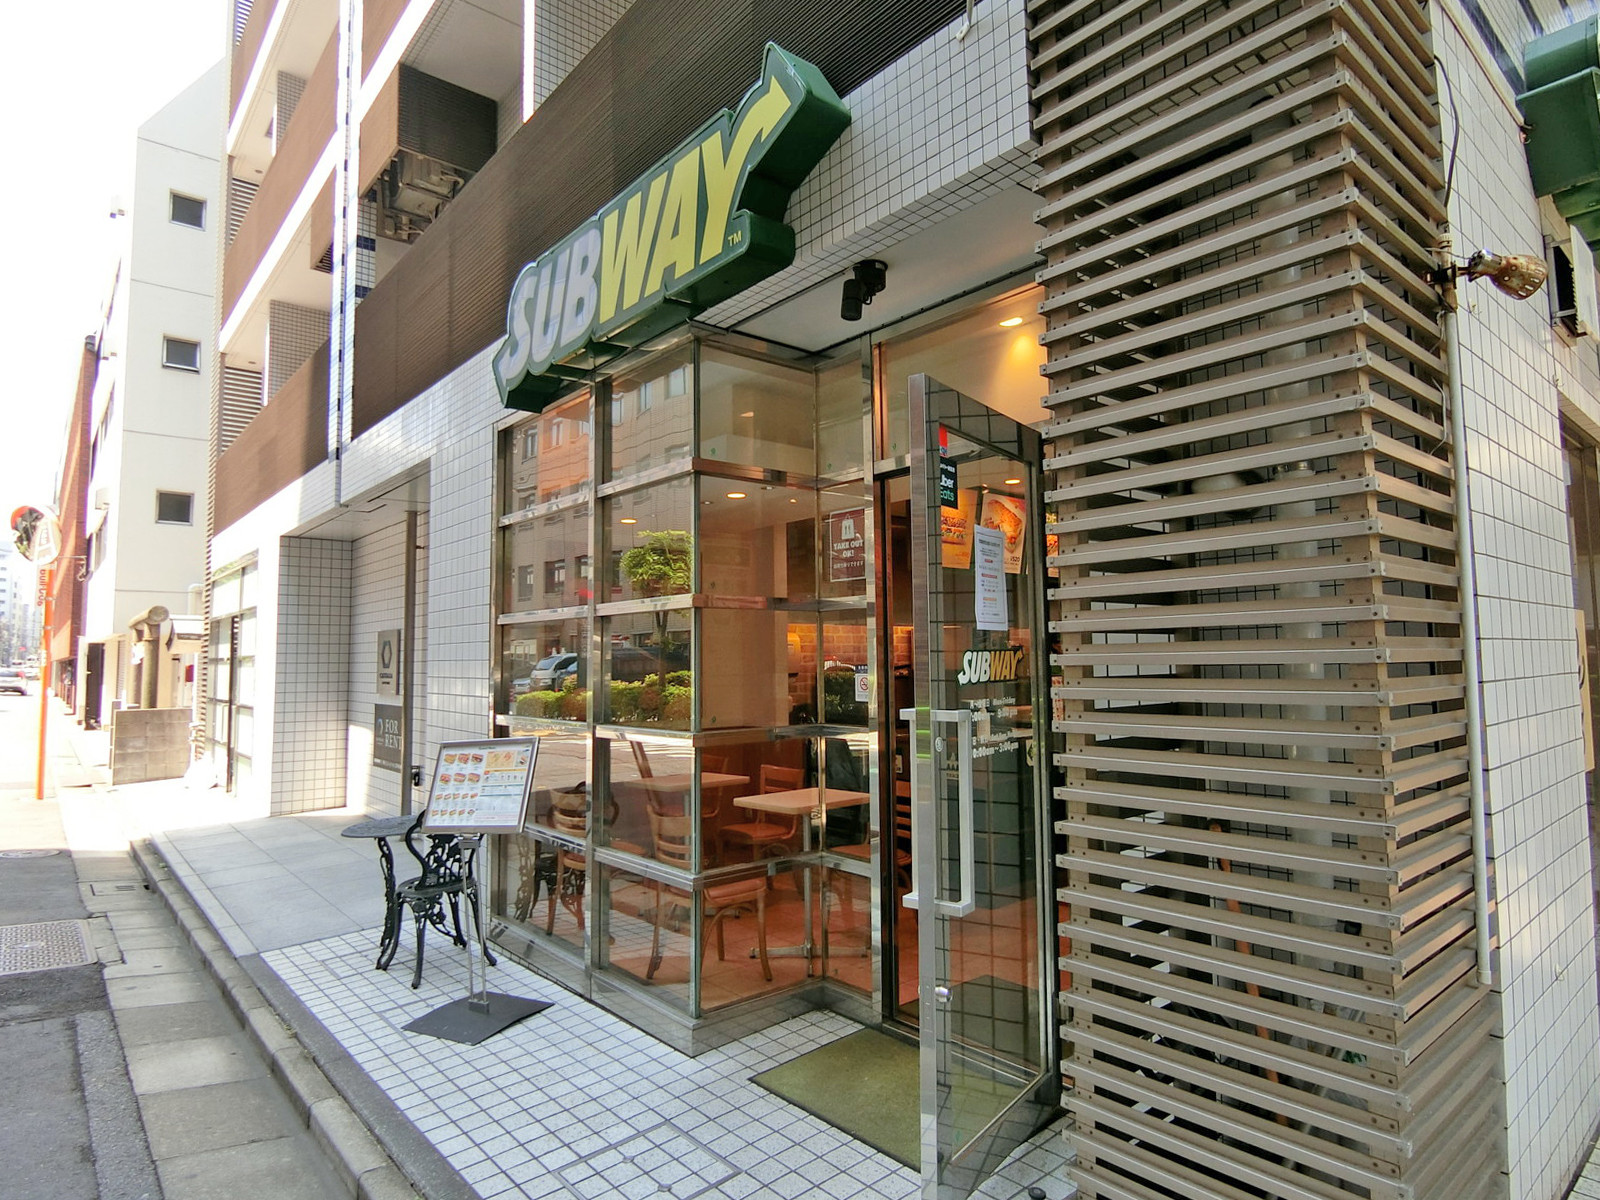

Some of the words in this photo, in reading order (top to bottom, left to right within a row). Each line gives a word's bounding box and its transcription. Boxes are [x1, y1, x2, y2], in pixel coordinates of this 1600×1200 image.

[501, 76, 791, 389] SUBWAY
[833, 541, 850, 550] TAKE
[850, 539, 863, 548] OUT
[842, 549, 855, 558] OK!
[957, 648, 1024, 686] SUBWAY
[385, 719, 399, 734] FOR
[384, 734, 402, 750] RENT
